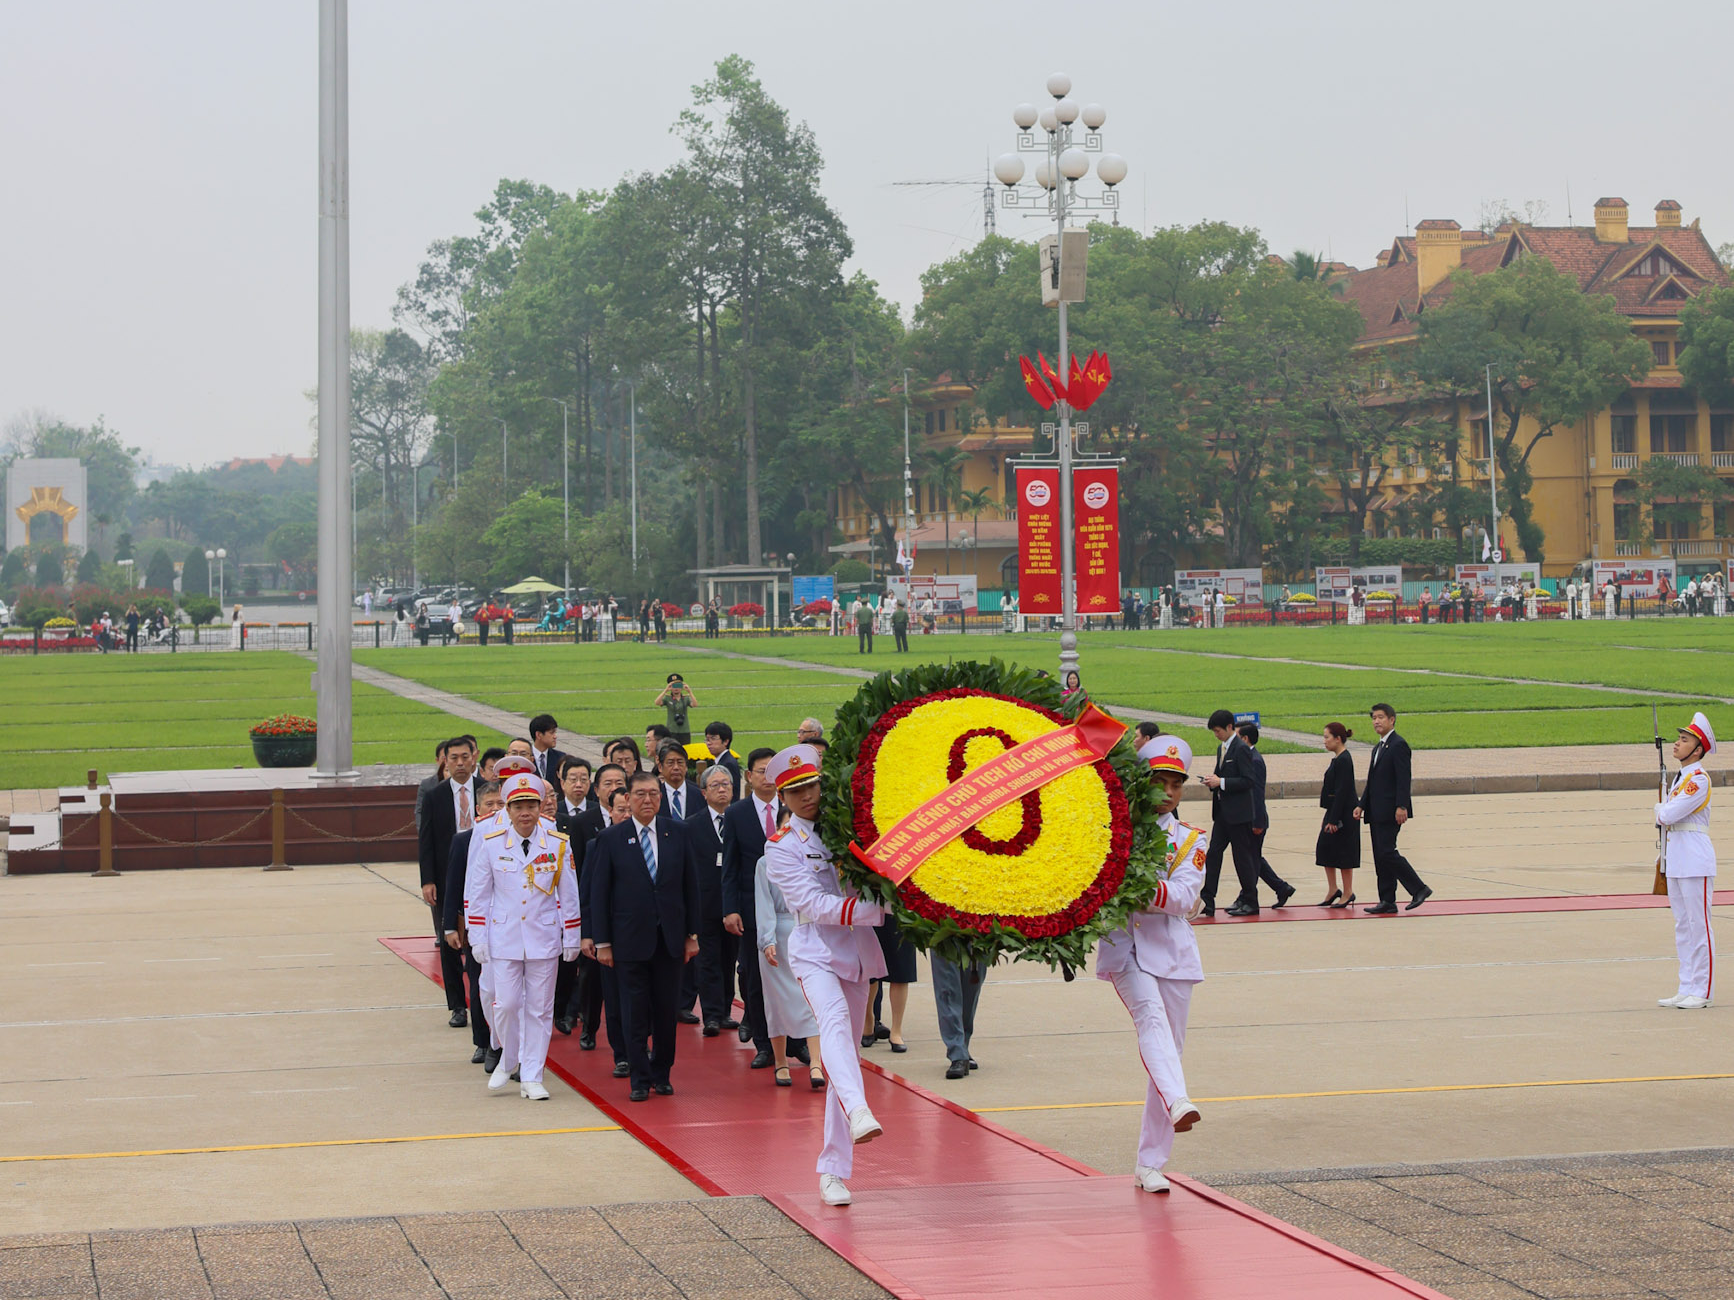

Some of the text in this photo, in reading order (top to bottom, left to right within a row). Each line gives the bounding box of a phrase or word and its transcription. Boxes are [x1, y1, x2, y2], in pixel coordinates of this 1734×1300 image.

[874, 733, 1080, 862] KÍNH VIẾNG CHỦ TỊCH HỒ CHÍ MINH
[890, 852, 913, 871] THỦ
[908, 831, 941, 856] TƯỚNG
[937, 815, 963, 835] NHẬT
[960, 803, 983, 819] BẢN
[978, 786, 1011, 807] ISHIBA
[1006, 767, 1045, 790] SHIGERU
[1040, 761, 1058, 773] VÀ
